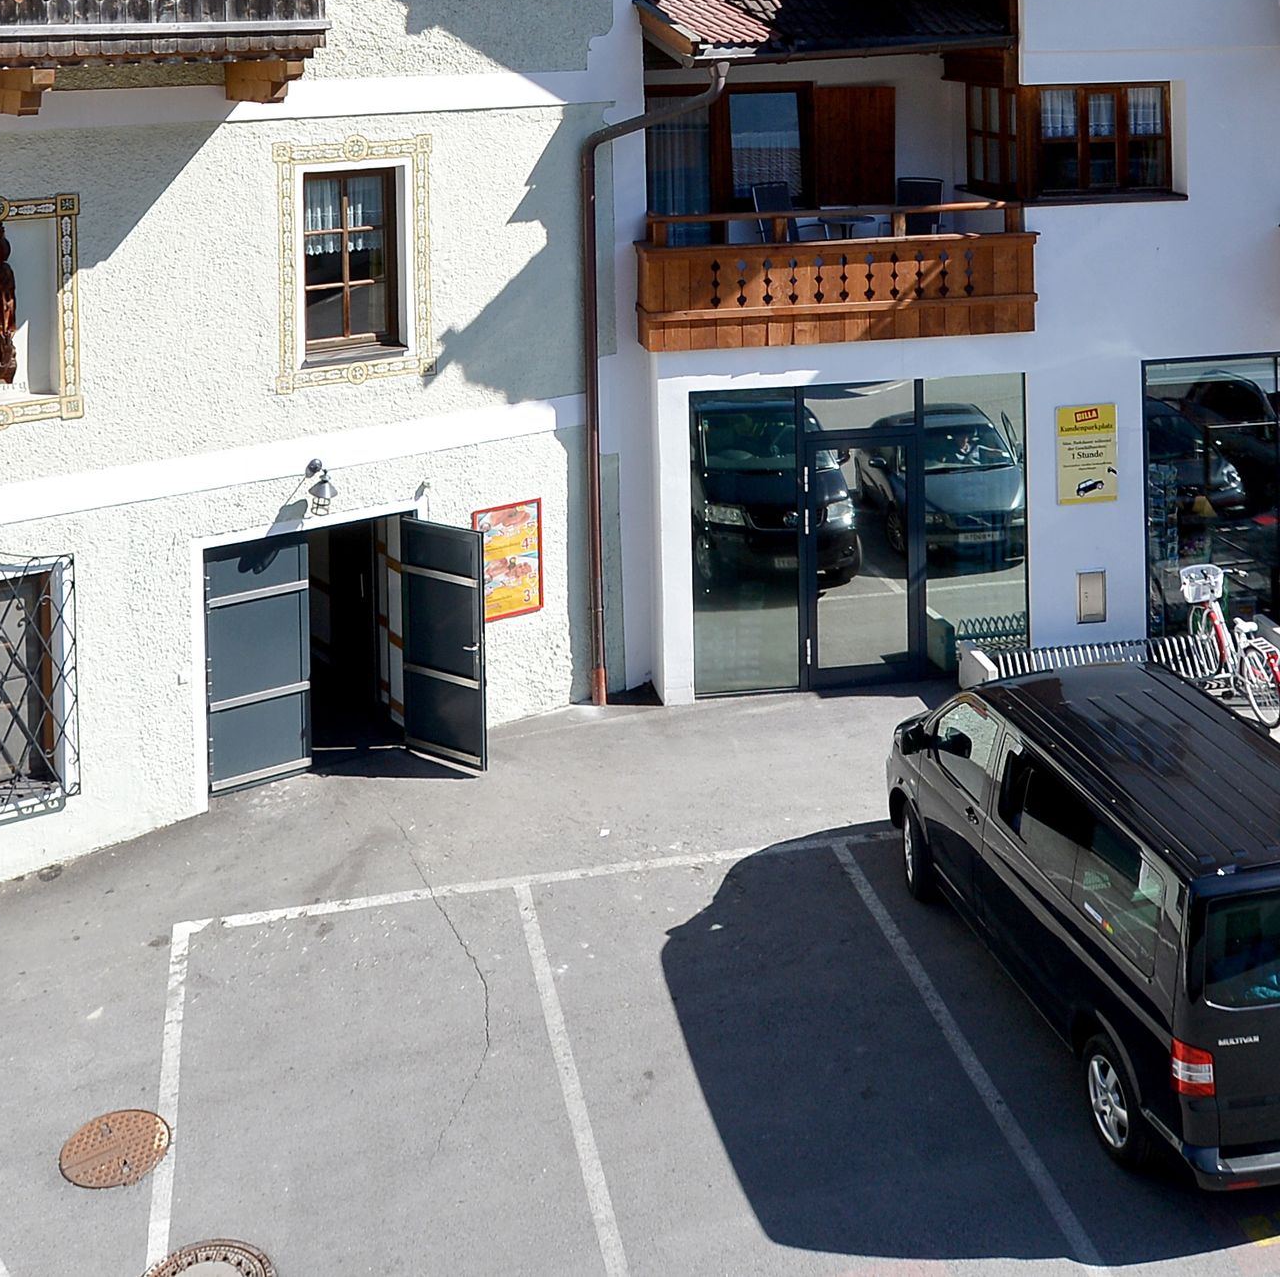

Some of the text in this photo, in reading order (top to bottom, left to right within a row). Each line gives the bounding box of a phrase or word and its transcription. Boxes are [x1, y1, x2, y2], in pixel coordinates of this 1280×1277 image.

[1075, 409, 1098, 422] BILLA
[1060, 423, 1113, 432] Kundenparkplatz
[1076, 449, 1104, 460] Stunde
[1217, 1035, 1260, 1047] MULTIVAN
